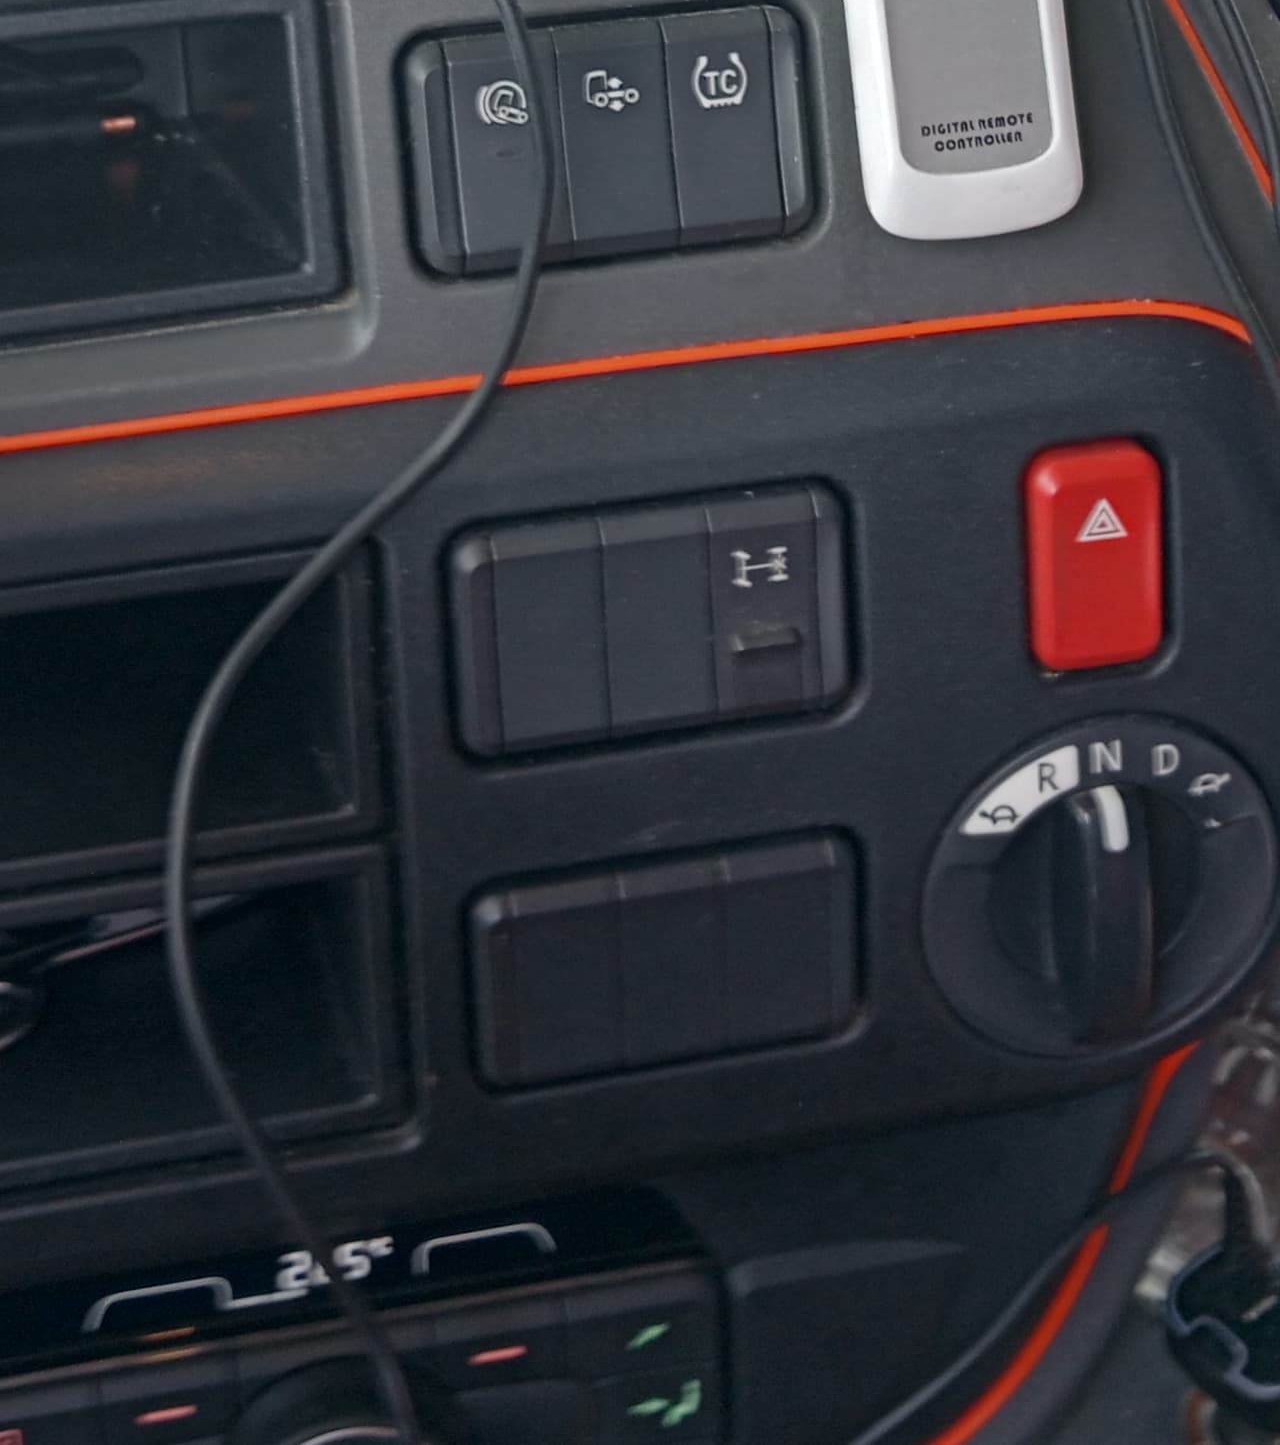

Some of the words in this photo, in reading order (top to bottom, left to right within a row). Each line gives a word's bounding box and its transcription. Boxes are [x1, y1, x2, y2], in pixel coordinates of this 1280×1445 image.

[703, 69, 738, 95] TC
[920, 120, 975, 137] DIGITAL
[978, 112, 1034, 130] REMOTE
[934, 130, 1024, 152] CONTROLLER
[1037, 763, 1059, 792] R
[1090, 739, 1123, 774] N
[1153, 744, 1180, 776] D
